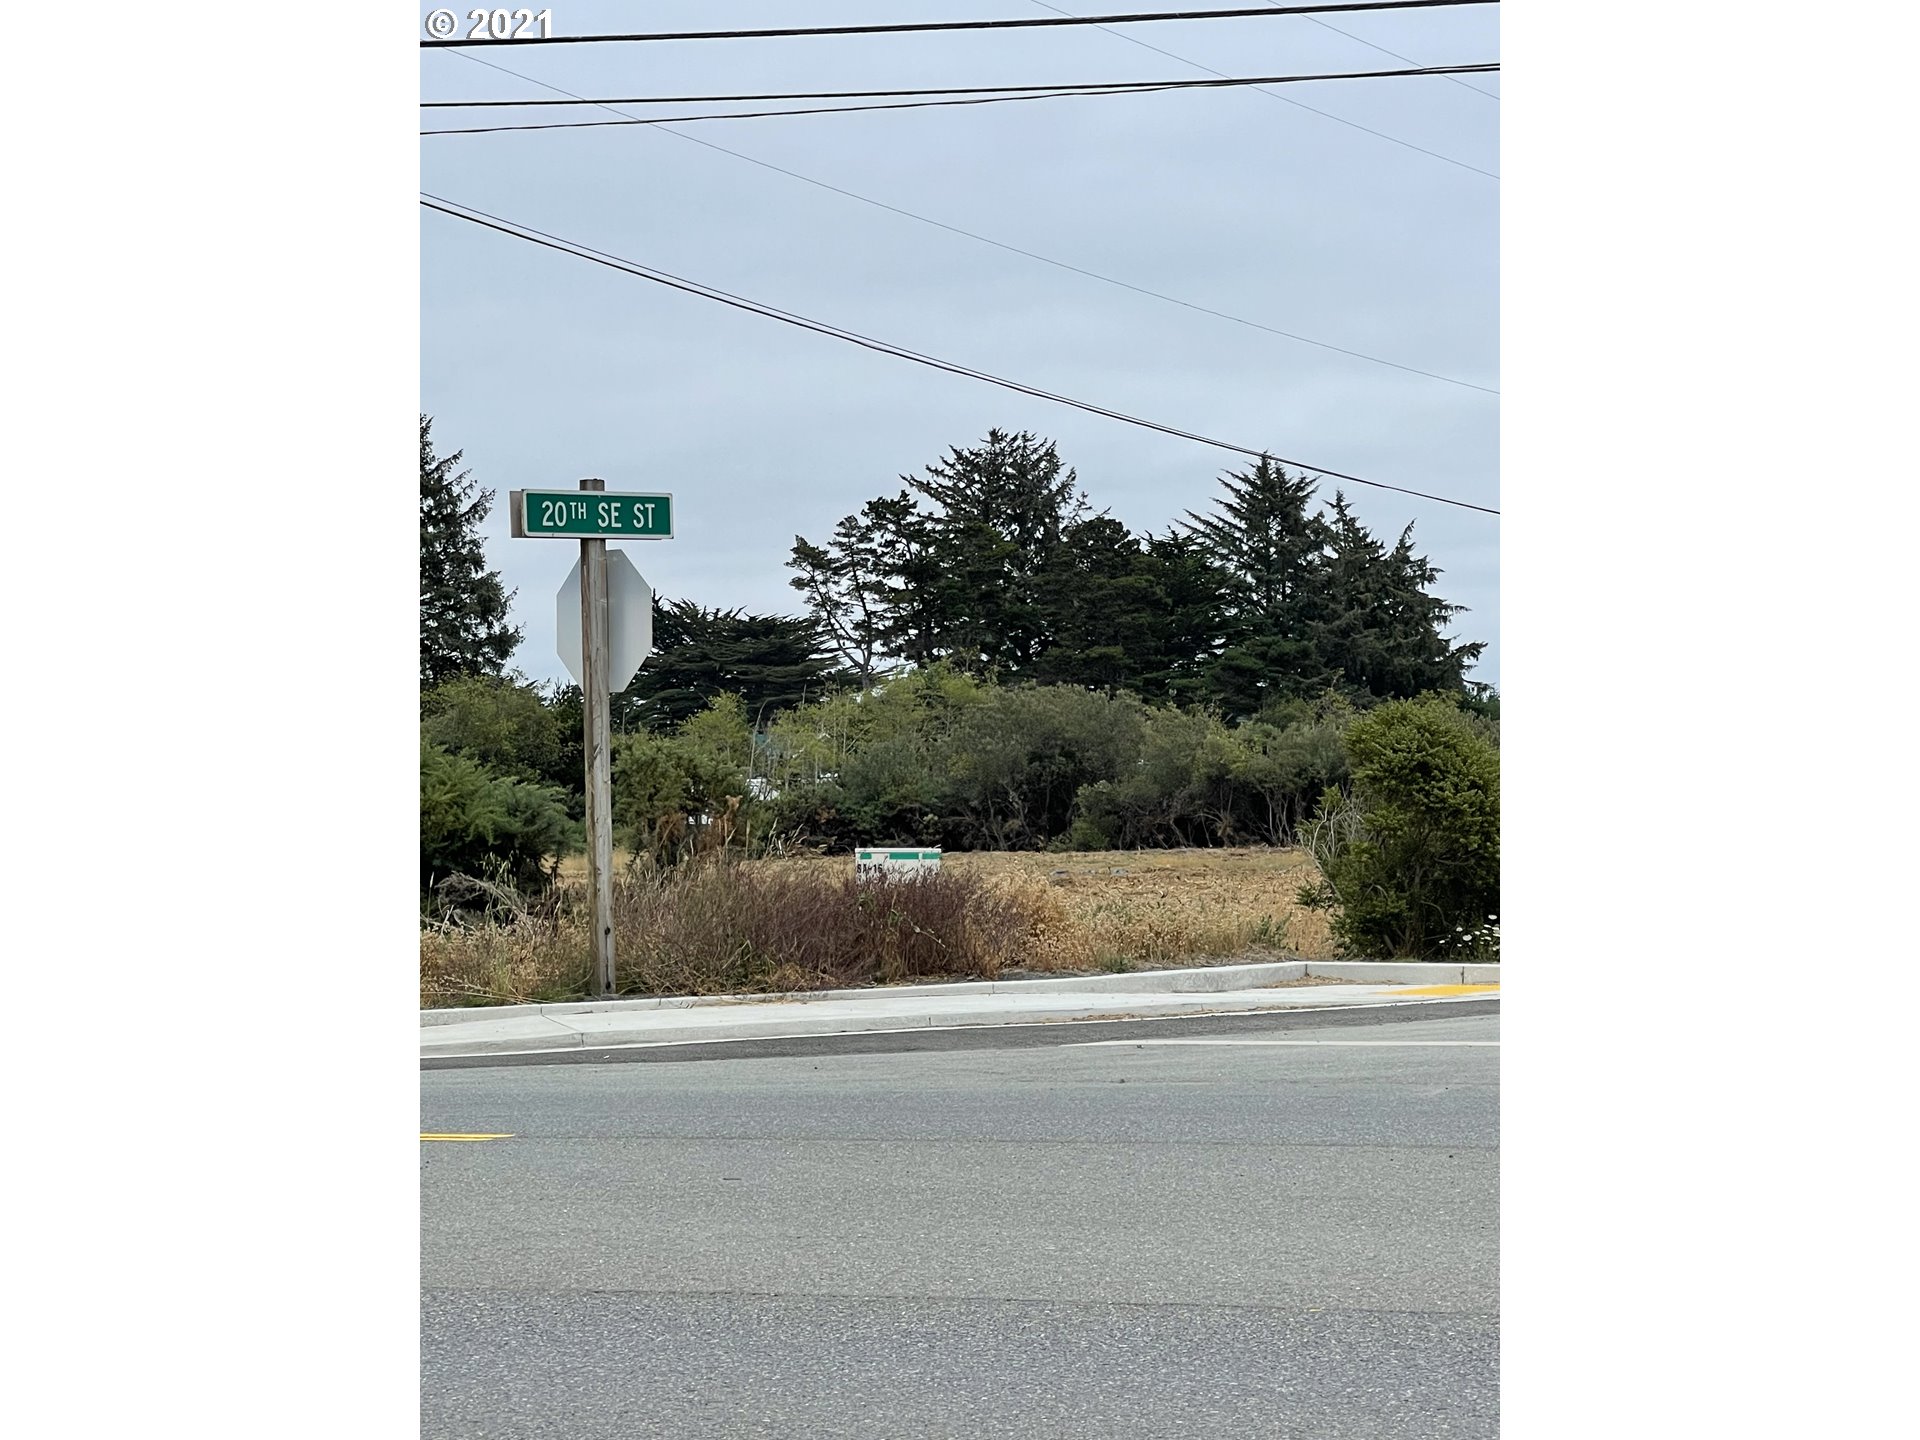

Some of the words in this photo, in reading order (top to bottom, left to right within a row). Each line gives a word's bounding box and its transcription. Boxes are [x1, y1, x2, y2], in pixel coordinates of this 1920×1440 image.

[541, 501, 587, 527] 20TH
[597, 502, 622, 528] SE
[633, 503, 656, 529] ST
